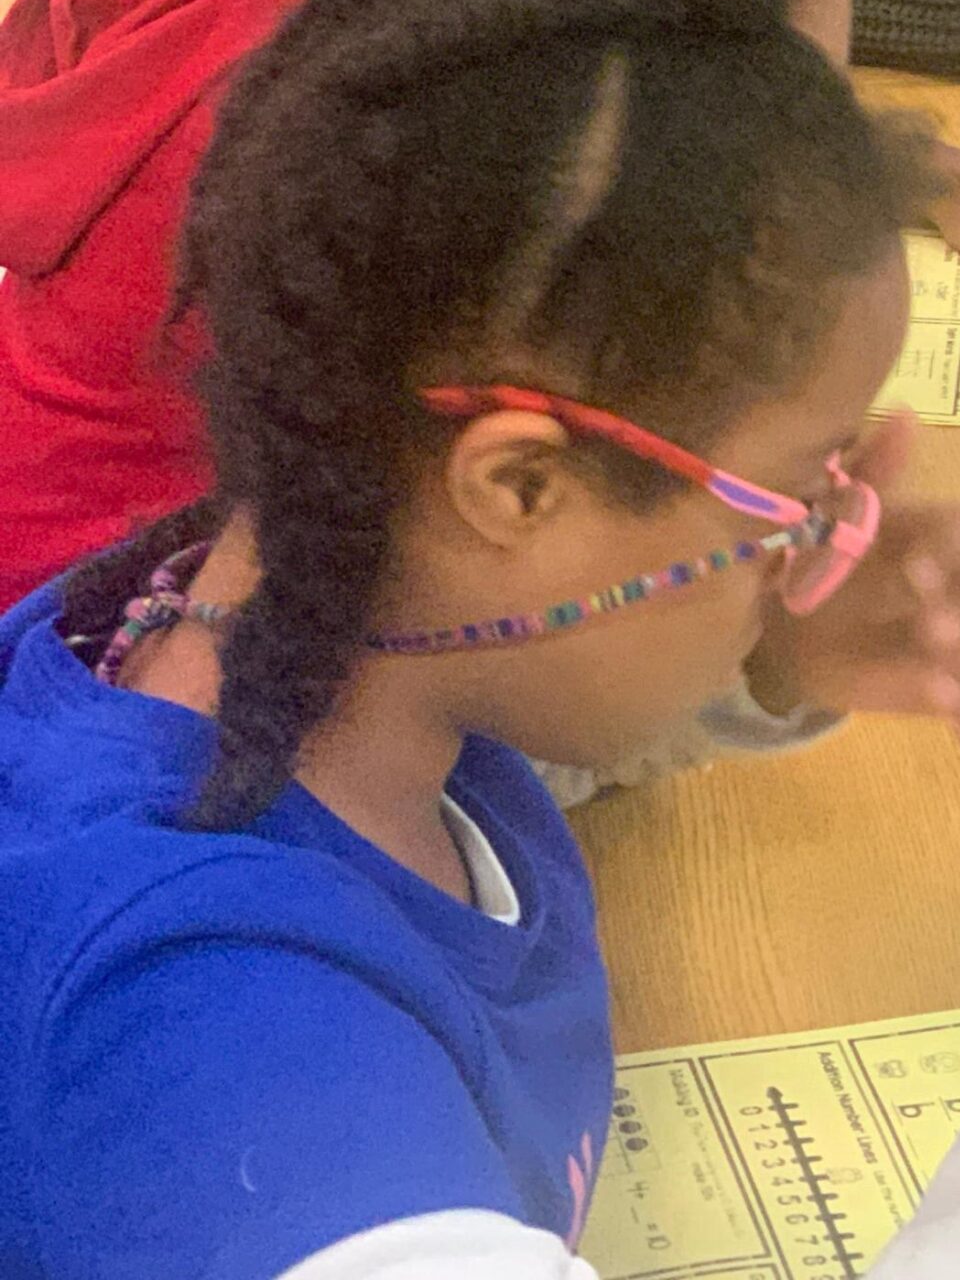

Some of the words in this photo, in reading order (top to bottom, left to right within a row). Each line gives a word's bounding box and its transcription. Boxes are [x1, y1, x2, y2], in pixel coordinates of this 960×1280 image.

[740, 1106, 762, 1116] 0
[818, 1051, 844, 1092] Addition
[837, 1092, 864, 1134] Number
[857, 1135, 878, 1165] Lines
[748, 1123, 770, 1132] 1
[754, 1139, 778, 1151] 2
[762, 1158, 786, 1168] 3
[777, 1195, 801, 1205] 5
[785, 1214, 809, 1225] 6
[794, 1234, 819, 1245] 7
[802, 1255, 827, 1266] 8
